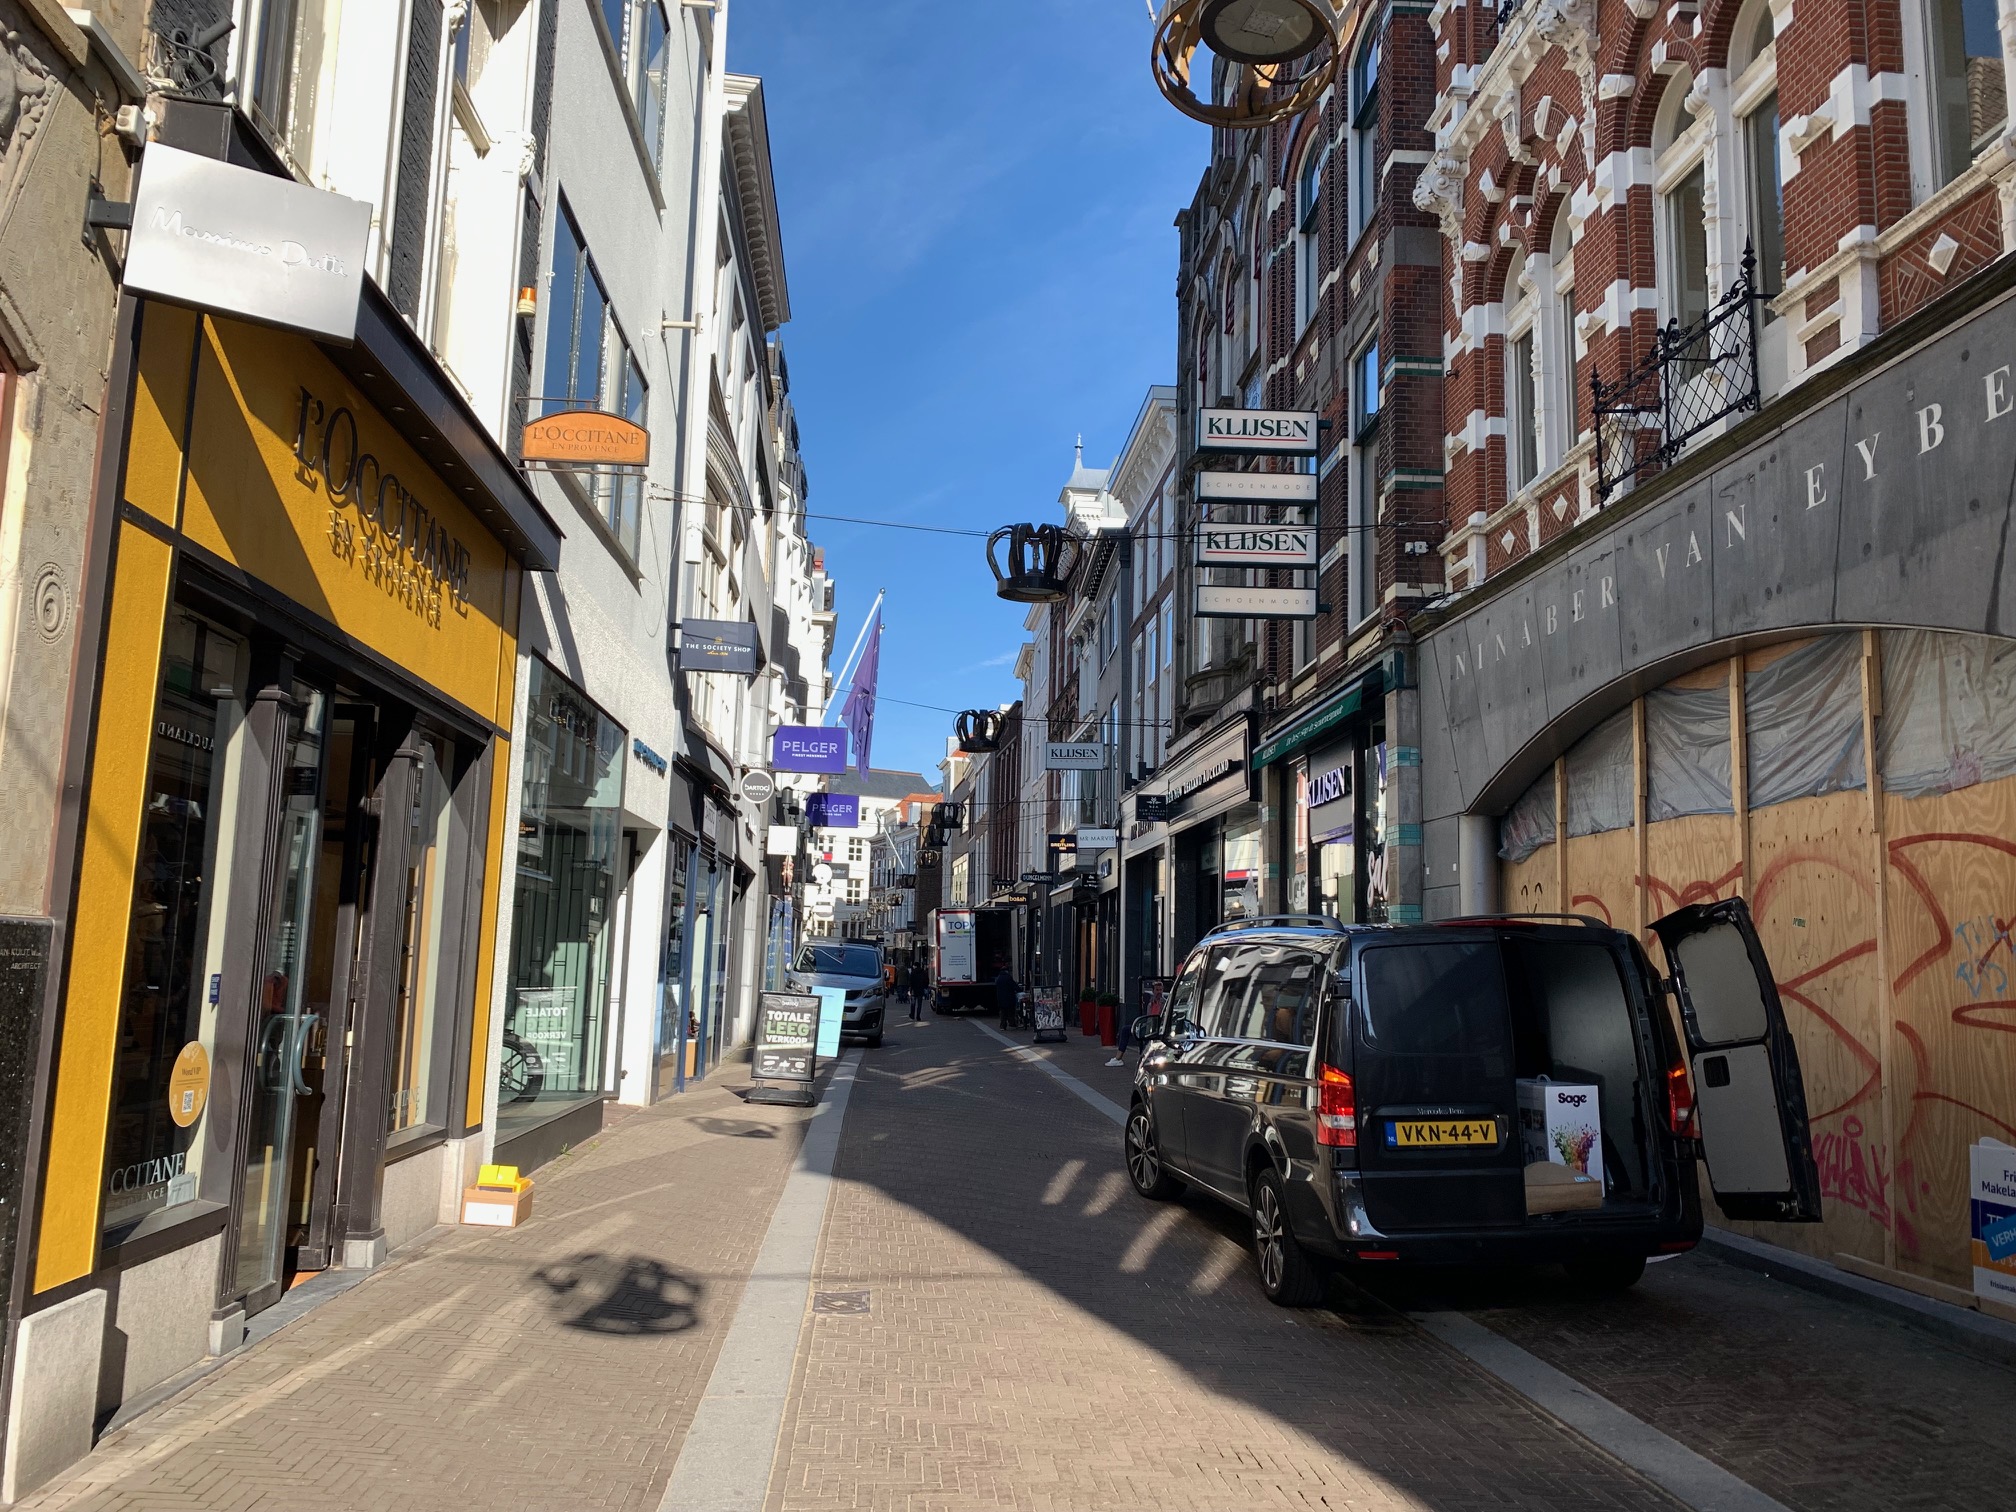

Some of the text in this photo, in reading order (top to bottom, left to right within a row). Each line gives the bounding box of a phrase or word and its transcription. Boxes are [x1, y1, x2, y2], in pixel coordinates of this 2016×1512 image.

[150, 206, 348, 277] Massimo Dutti
[1207, 417, 1310, 438] KLIJSEN
[533, 426, 640, 445] L'OCCITANE
[552, 442, 619, 453] EN PROVENCE
[1206, 482, 1310, 491] SCHOENMODE
[294, 386, 471, 605] L'OCCITANE
[1456, 364, 2014, 680] NINABER VAN EYBE
[1206, 531, 1309, 552] KLIJSEN
[1204, 597, 1309, 605] SCHOENMODE
[782, 740, 838, 753] PELGER
[1050, 748, 1099, 758] KLIJSEN
[1307, 764, 1346, 809] KLIJSEN
[812, 803, 853, 813] PELGER
[767, 1010, 811, 1022] TOTALE
[766, 1021, 810, 1036] LEEG
[766, 1034, 808, 1044] VERKOOP
[1558, 1092, 1588, 1107] Sage
[1401, 1124, 1490, 1142] VKN-44-V
